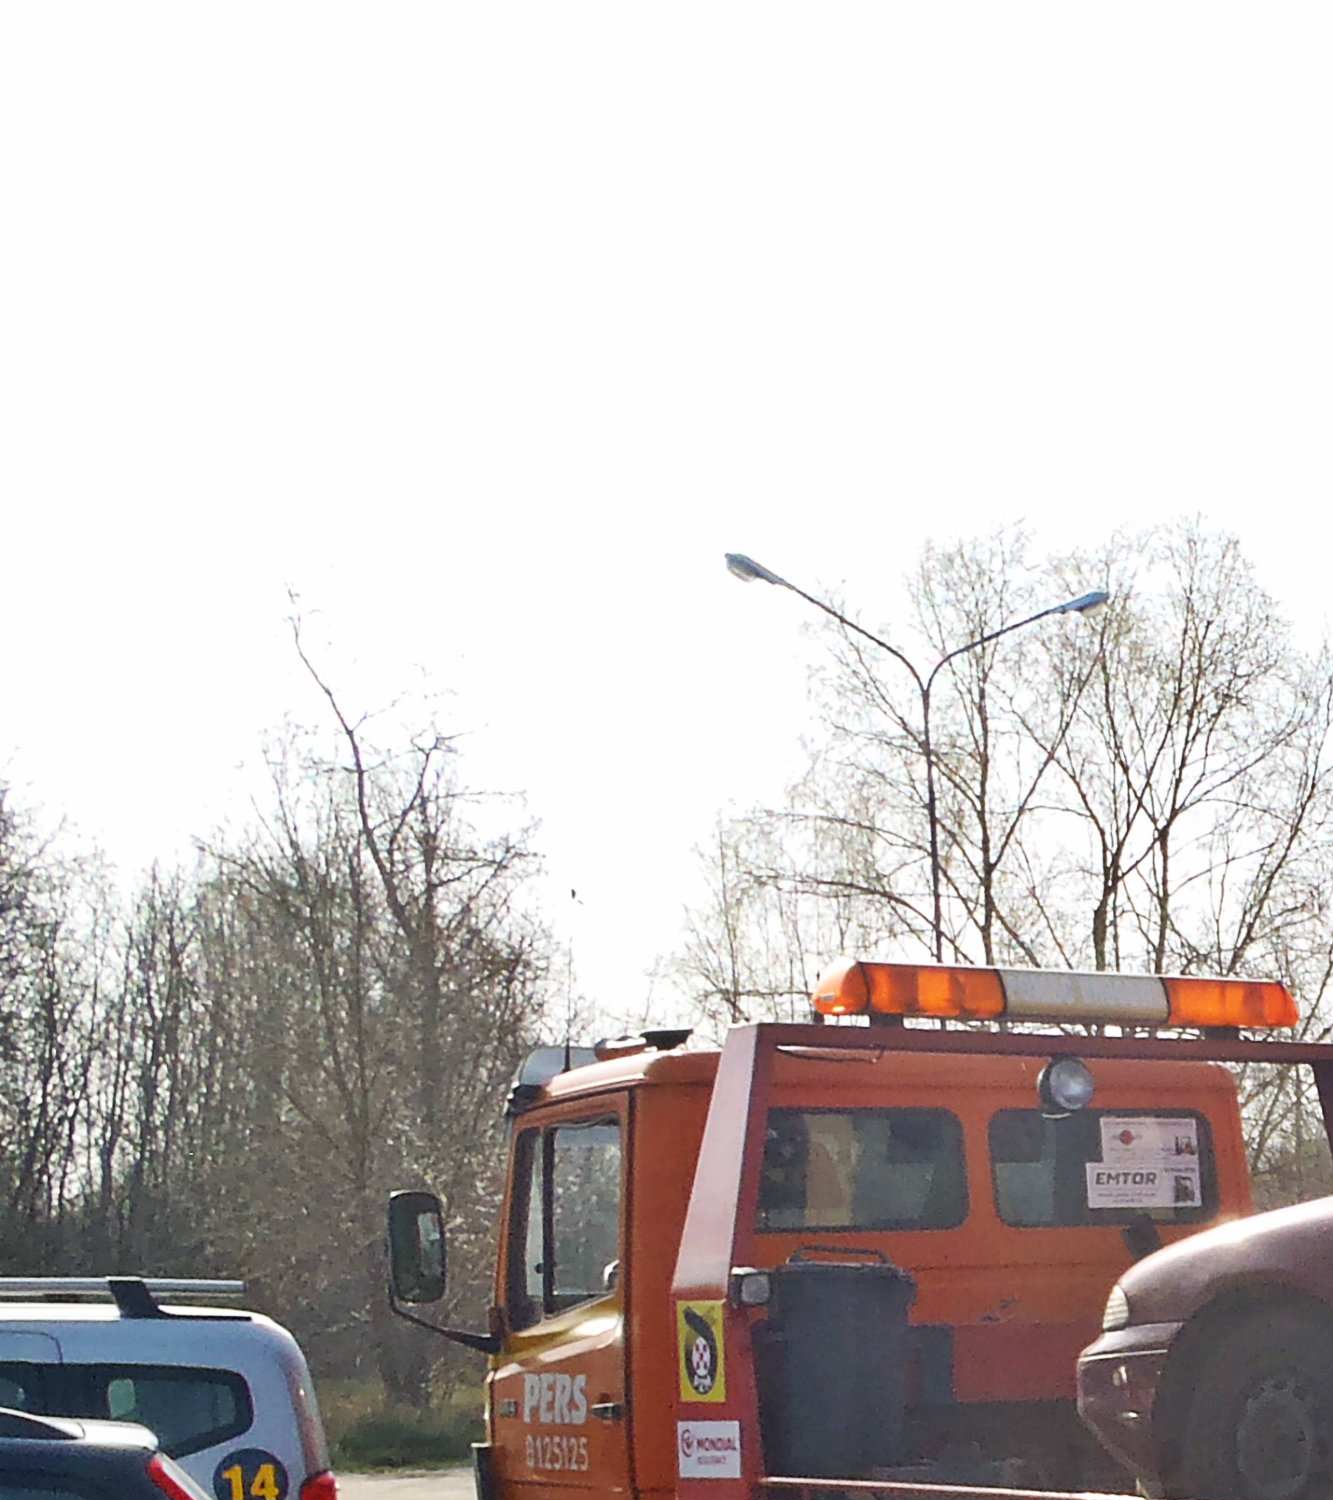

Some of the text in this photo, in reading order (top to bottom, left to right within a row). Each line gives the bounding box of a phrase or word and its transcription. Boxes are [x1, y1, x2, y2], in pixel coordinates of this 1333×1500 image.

[1095, 1172, 1157, 1185] EMTOR
[524, 1372, 587, 1424] PERS
[697, 1437, 737, 1451] MONDIAL
